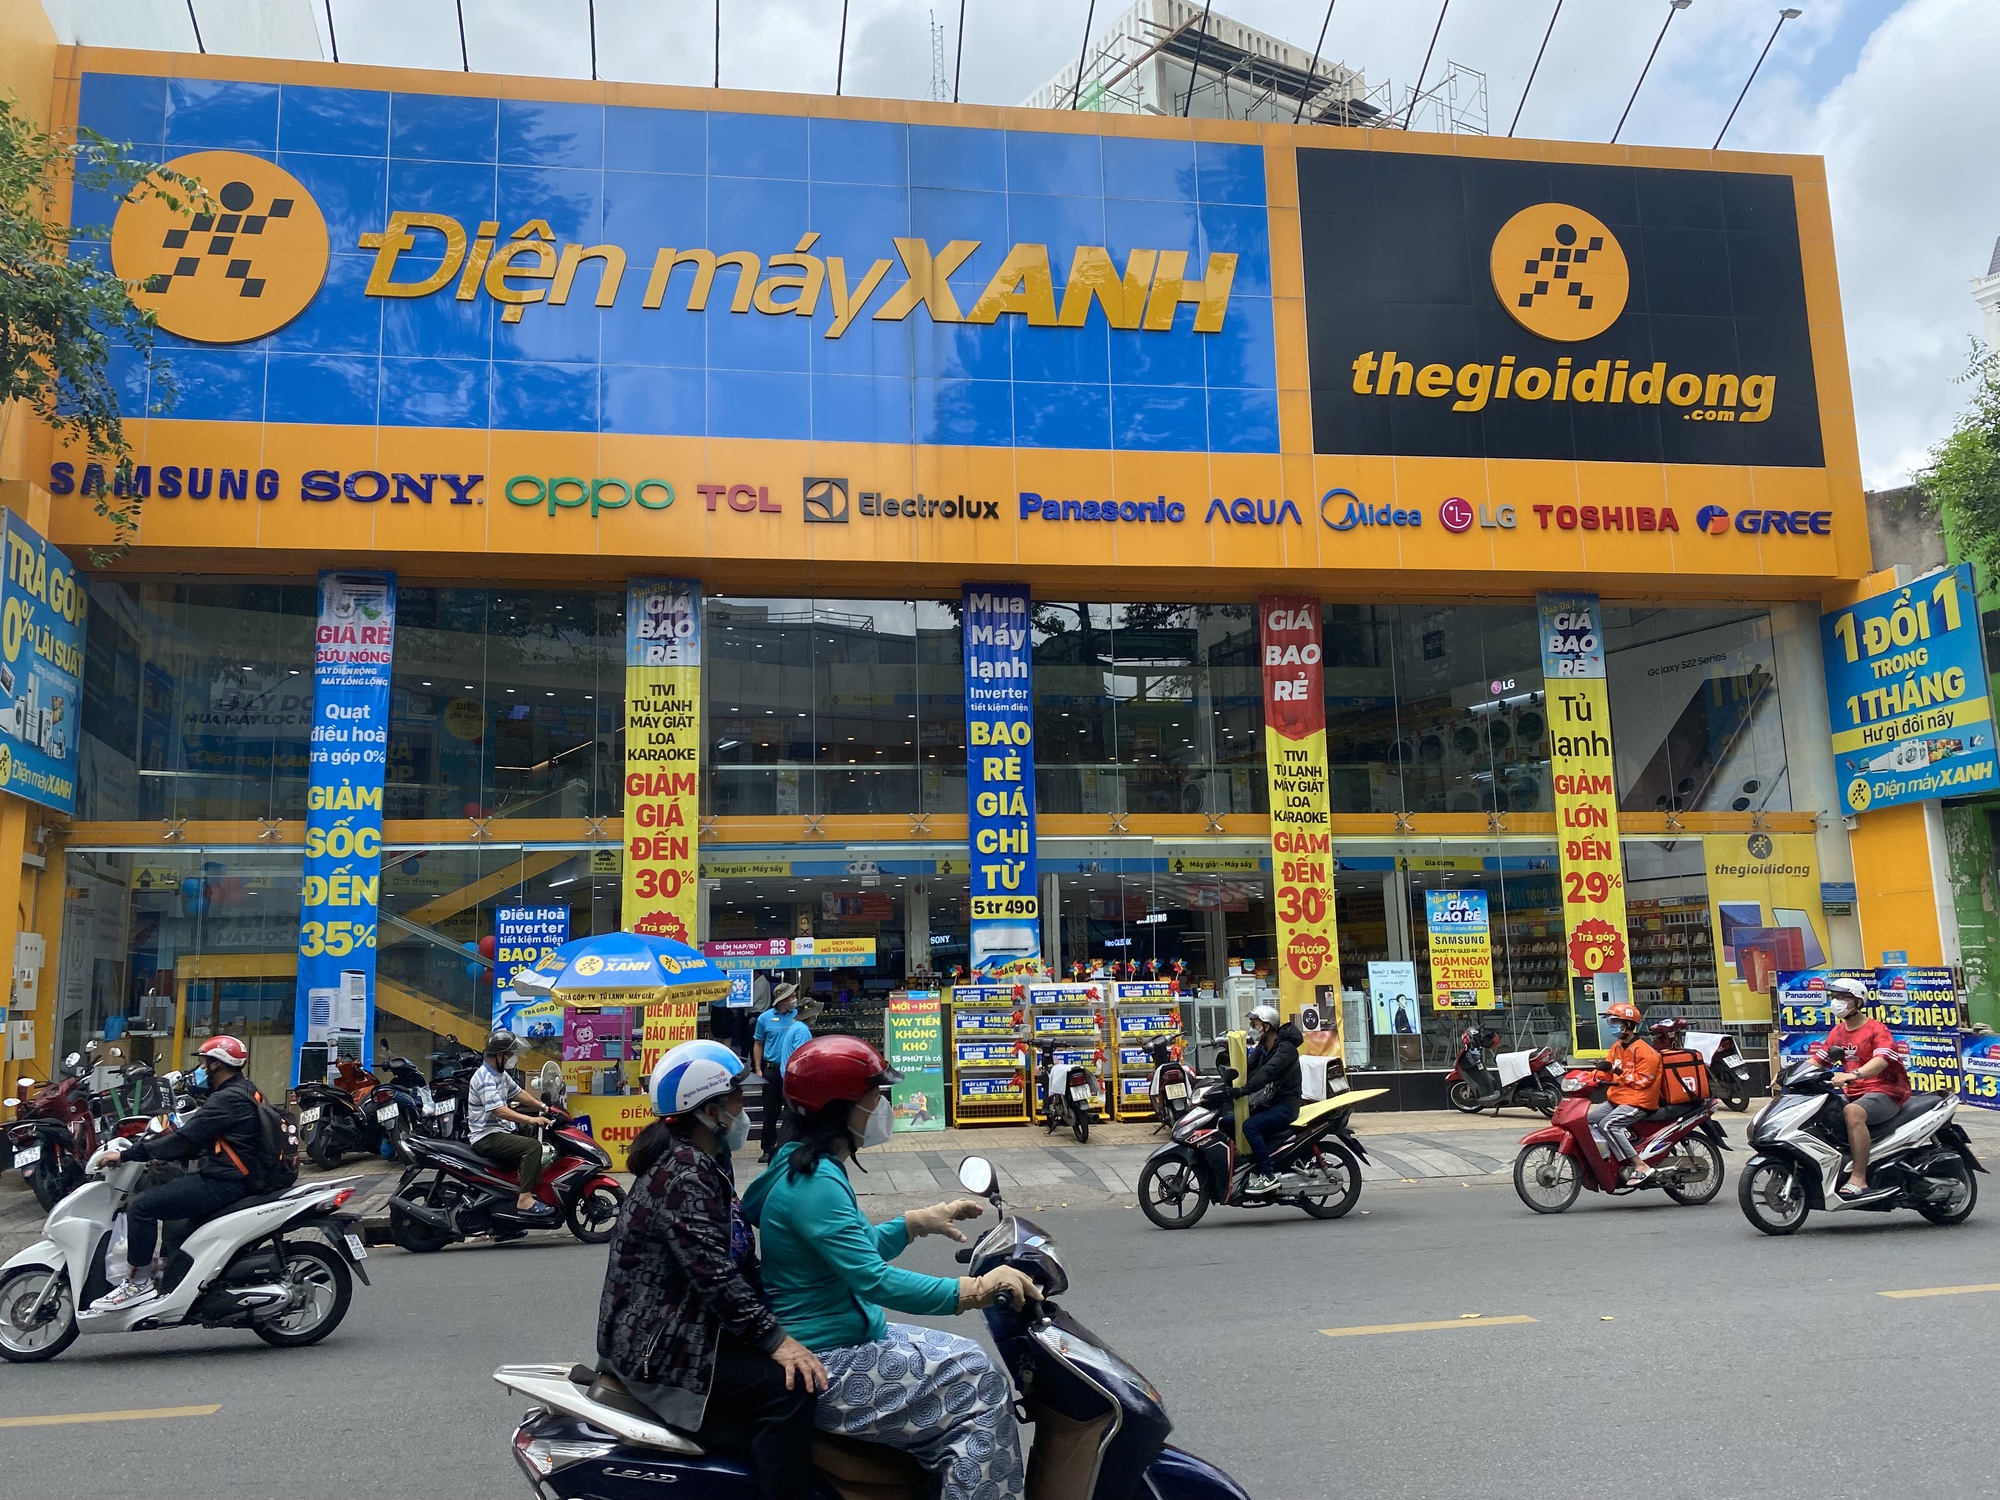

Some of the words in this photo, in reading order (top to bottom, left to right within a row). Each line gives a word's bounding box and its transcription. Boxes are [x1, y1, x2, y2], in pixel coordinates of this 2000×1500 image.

[358, 211, 626, 323] Điện
[1352, 350, 1776, 422] thegioididong
[1683, 407, 1735, 422] .com
[50, 462, 279, 500] SAMSUNG
[301, 470, 484, 504] SONY
[697, 484, 782, 513] TCL
[858, 492, 999, 519] Electrolux
[1019, 493, 1186, 522] Panasonic
[1205, 498, 1303, 525] AQUA
[1337, 502, 1422, 527] Midea
[1479, 504, 1516, 528] LG
[1533, 504, 1680, 532] TOSHIBA
[1734, 509, 1833, 535] GREE
[8, 529, 47, 604] TRẢ
[50, 567, 88, 628] GÓP
[644, 591, 691, 615] GIÁ
[969, 592, 1026, 615] Mua
[1268, 603, 1313, 631] GIÁ
[1553, 607, 1592, 631] GIÁ
[1835, 612, 1859, 664] 1
[1863, 588, 1931, 657] ĐỔI
[1932, 576, 1962, 632] 1
[3, 596, 34, 662] 0%
[34, 624, 54, 663] LÃI
[54, 640, 83, 680] SUẤT
[316, 621, 357, 645] GIÁ
[361, 619, 392, 646] RẺ
[635, 619, 696, 639] BAO
[971, 622, 1027, 651] Máy
[315, 648, 347, 663] CỨU
[349, 647, 391, 664] NÓNG
[645, 638, 681, 664] RẺ
[1265, 643, 1321, 666] BAO
[1548, 635, 1598, 653] BAO
[970, 656, 1028, 684] lạnh
[1557, 653, 1588, 677] RẺ
[1647, 661, 1680, 677] Galaxy
[1681, 658, 1697, 670] S22
[1697, 652, 1727, 666] Series
[1871, 647, 1928, 680] TRONG
[649, 684, 675, 697] TIVI
[970, 687, 1029, 700] Inverter
[1274, 671, 1309, 702] RẺ
[1502, 678, 1515, 690] LG
[1846, 695, 1861, 725] 1
[1861, 666, 1966, 724] THÁNG
[325, 703, 371, 723] Quạt
[632, 696, 650, 712] TỦ
[653, 699, 692, 716] LẠNH
[1558, 692, 1592, 722] Tủ
[630, 713, 659, 729] MÁY
[662, 712, 695, 731] GIẶT
[1863, 724, 1884, 744] Hư
[1887, 721, 1901, 744] gì
[1902, 711, 1924, 735] đổi
[1927, 708, 1955, 729] nấy
[310, 724, 348, 743] điều
[352, 726, 386, 743] hoà
[648, 732, 675, 745] LOA
[970, 721, 1031, 746] BAO
[331, 749, 361, 766] góp
[363, 750, 386, 764] 0%
[628, 748, 696, 761] KARAOKE
[1284, 750, 1308, 762] TIVI
[1550, 729, 1610, 764] lạnh
[12, 758, 32, 787] Điện
[983, 748, 1022, 782] RẺ
[1274, 761, 1287, 778] TỦ
[1288, 764, 1322, 781] LẠNH
[626, 765, 696, 796] GIẢM
[1274, 777, 1297, 793] MÁY
[1297, 777, 1325, 796] GIẶT
[1554, 768, 1613, 795] GIẢM
[1872, 780, 1906, 801] Điện
[307, 778, 382, 811] GIẢM
[976, 785, 1029, 817] GIÁ
[1286, 795, 1311, 808] LOA
[635, 797, 684, 828] GIÁ
[1274, 810, 1328, 824] KARAOKE
[1564, 802, 1608, 828] LỚN
[305, 816, 381, 858] SỐC
[630, 829, 689, 861] ĐẾN
[976, 821, 1030, 854] CHỈ
[1273, 826, 1330, 854] GIẢM
[1566, 832, 1612, 861] ĐẾN
[713, 865, 730, 875] Máy
[730, 865, 747, 875] giặt
[752, 865, 769, 874] Máy
[769, 864, 784, 874] sấy
[981, 858, 1026, 890] TỪ
[1281, 854, 1325, 884] ĐẾN
[1714, 863, 1811, 878] thegioididong
[302, 863, 379, 907] ĐẾN
[393, 877, 410, 887] Gia
[411, 877, 440, 888] dụng
[635, 868, 695, 899] 30%
[1564, 871, 1622, 904] 29%
[500, 908, 534, 920] Điều
[536, 908, 565, 920] Hoà
[1277, 885, 1333, 924] 30%
[1433, 911, 1461, 922] BAO
[1464, 906, 1482, 921] RẺ
[1447, 897, 1470, 910] GIÁ
[301, 921, 377, 958] 35%
[500, 923, 565, 934] Inverter
[641, 922, 658, 932] Trả
[661, 922, 680, 934] góp
[930, 935, 950, 944] SONY
[1577, 931, 1594, 943] Trả
[1595, 931, 1616, 945] góp
[500, 935, 516, 944] tiết
[518, 935, 541, 945] kiệm
[543, 935, 564, 944] điện
[715, 942, 731, 950] ĐIỂM
[732, 942, 762, 951] NẠP/RÚT
[1289, 941, 1307, 954] TRẢ
[1307, 942, 1326, 954] GÓP
[1435, 936, 1485, 945] SAMSUNG
[603, 961, 651, 972] XANH
[802, 957, 824, 967] BÁN
[826, 956, 847, 967] TRẢ
[848, 955, 866, 966] GÓP
[1298, 955, 1317, 975] 0%
[1432, 954, 1462, 966] GIẢM
[1462, 955, 1490, 966] NGAY
[1584, 945, 1615, 971] 0%
[1441, 966, 1450, 978] 2
[1452, 967, 1483, 981] TRIỆU
[560, 993, 572, 1001] TRẢ
[600, 991, 608, 1000] TỦ
[609, 993, 625, 1001] LẠNH
[628, 992, 641, 1000] MÁY
[641, 993, 655, 1001] GIẶT
[892, 1001, 910, 1010] MỚI
[918, 1002, 940, 1010] HOT
[1785, 991, 1822, 999] Panasonic
[1907, 989, 1934, 1002] TẶNG
[1934, 988, 1954, 1001] GÓI
[891, 1018, 913, 1027] VAY
[1782, 1006, 1817, 1026] 1.3
[645, 1021, 666, 1041] BẢO
[669, 1020, 695, 1041] HIỂM
[895, 1028, 937, 1039] KHÔNG
[892, 1055, 901, 1063] 15
[902, 1054, 924, 1062] PHÚT
[1910, 1053, 1938, 1069] TẶNG
[1939, 1054, 1958, 1069] GÓI
[1964, 1073, 1998, 1098] 1.3
[621, 1104, 654, 1118] ĐIỂM
[602, 1467, 680, 1484] LEAD
